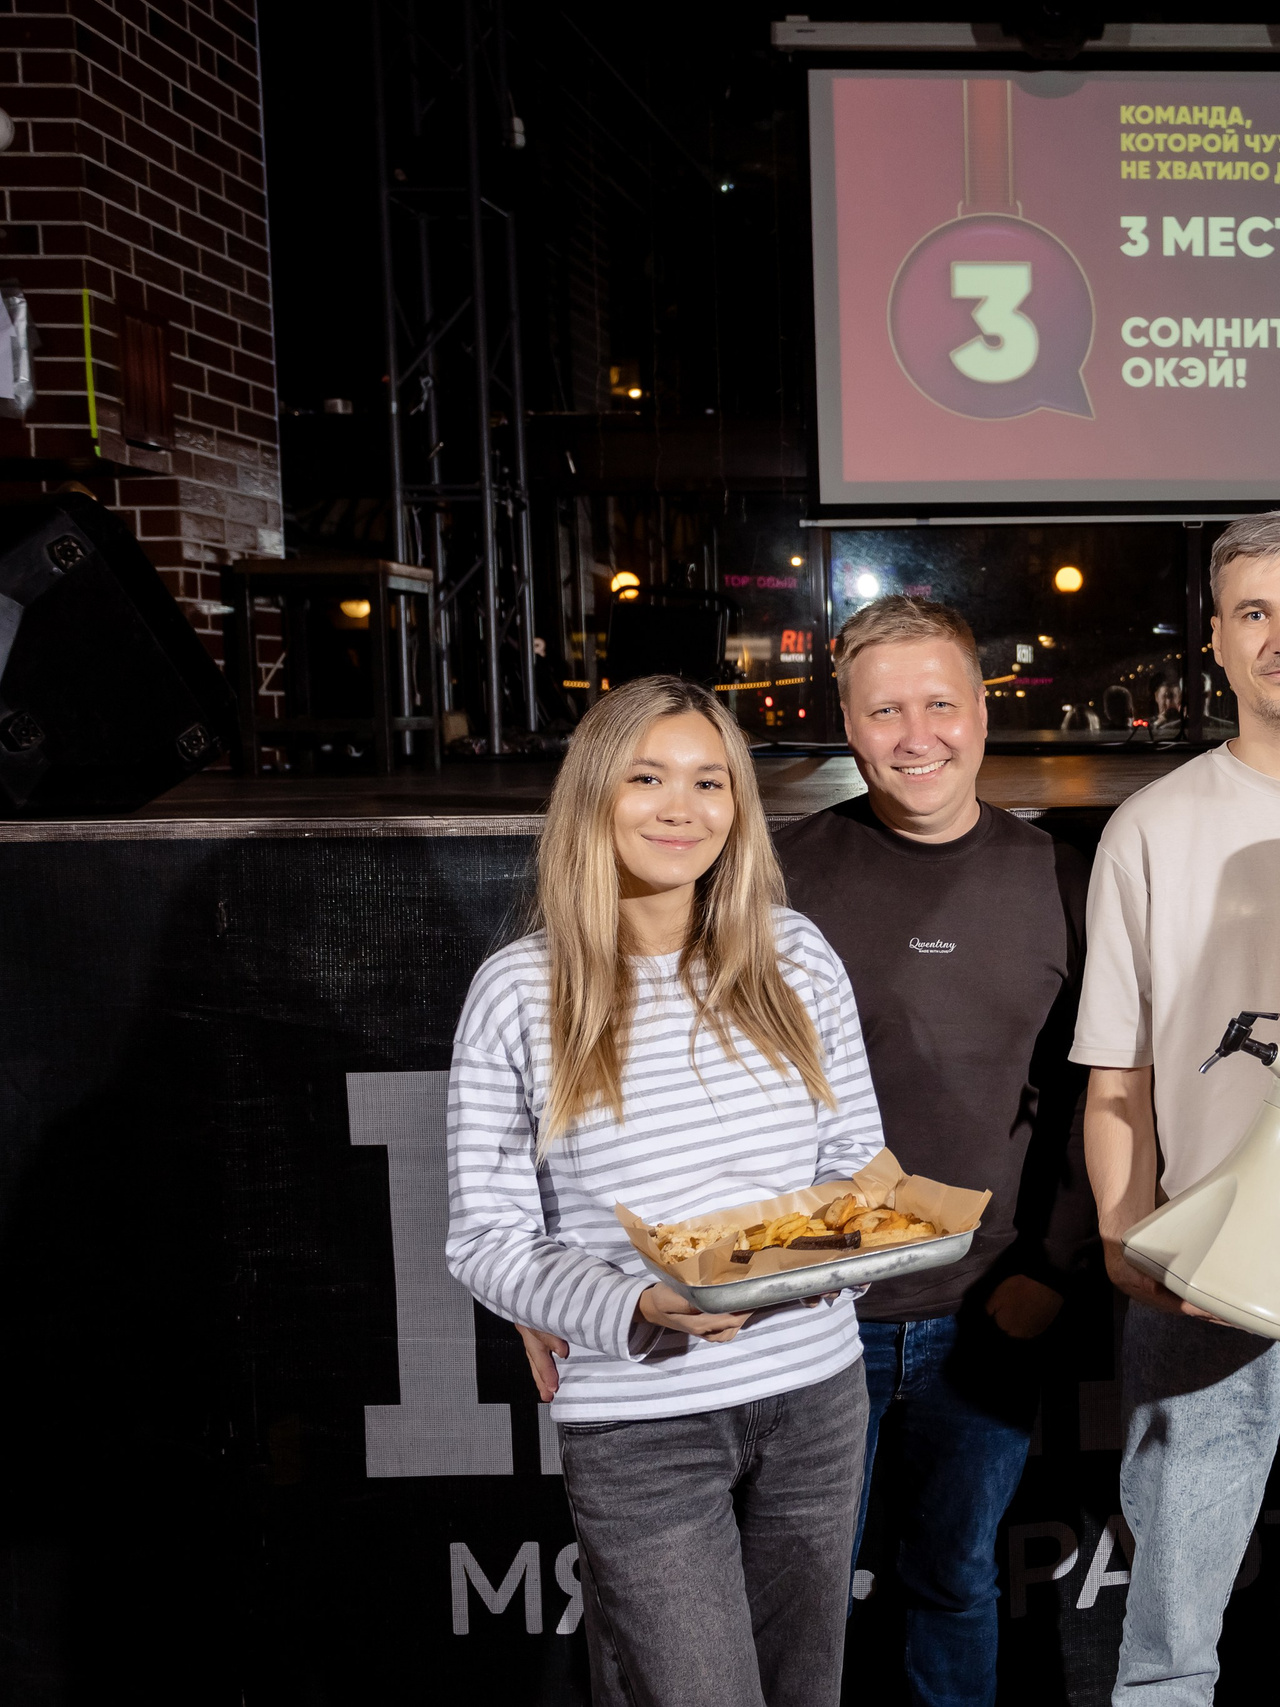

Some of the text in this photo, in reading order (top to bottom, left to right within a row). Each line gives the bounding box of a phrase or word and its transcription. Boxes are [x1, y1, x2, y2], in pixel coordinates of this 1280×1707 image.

[1119, 105, 1253, 128] КОМАНДА,
[1119, 128, 1240, 154] КОТОРОЙ
[1120, 161, 1151, 180] НЕ
[1156, 161, 1271, 182] ХВАТИЛО
[1119, 216, 1150, 258] 3
[950, 262, 1038, 382] 3
[1121, 350, 1248, 389] ОКЭЙ!
[909, 937, 957, 953] Qwentiny
